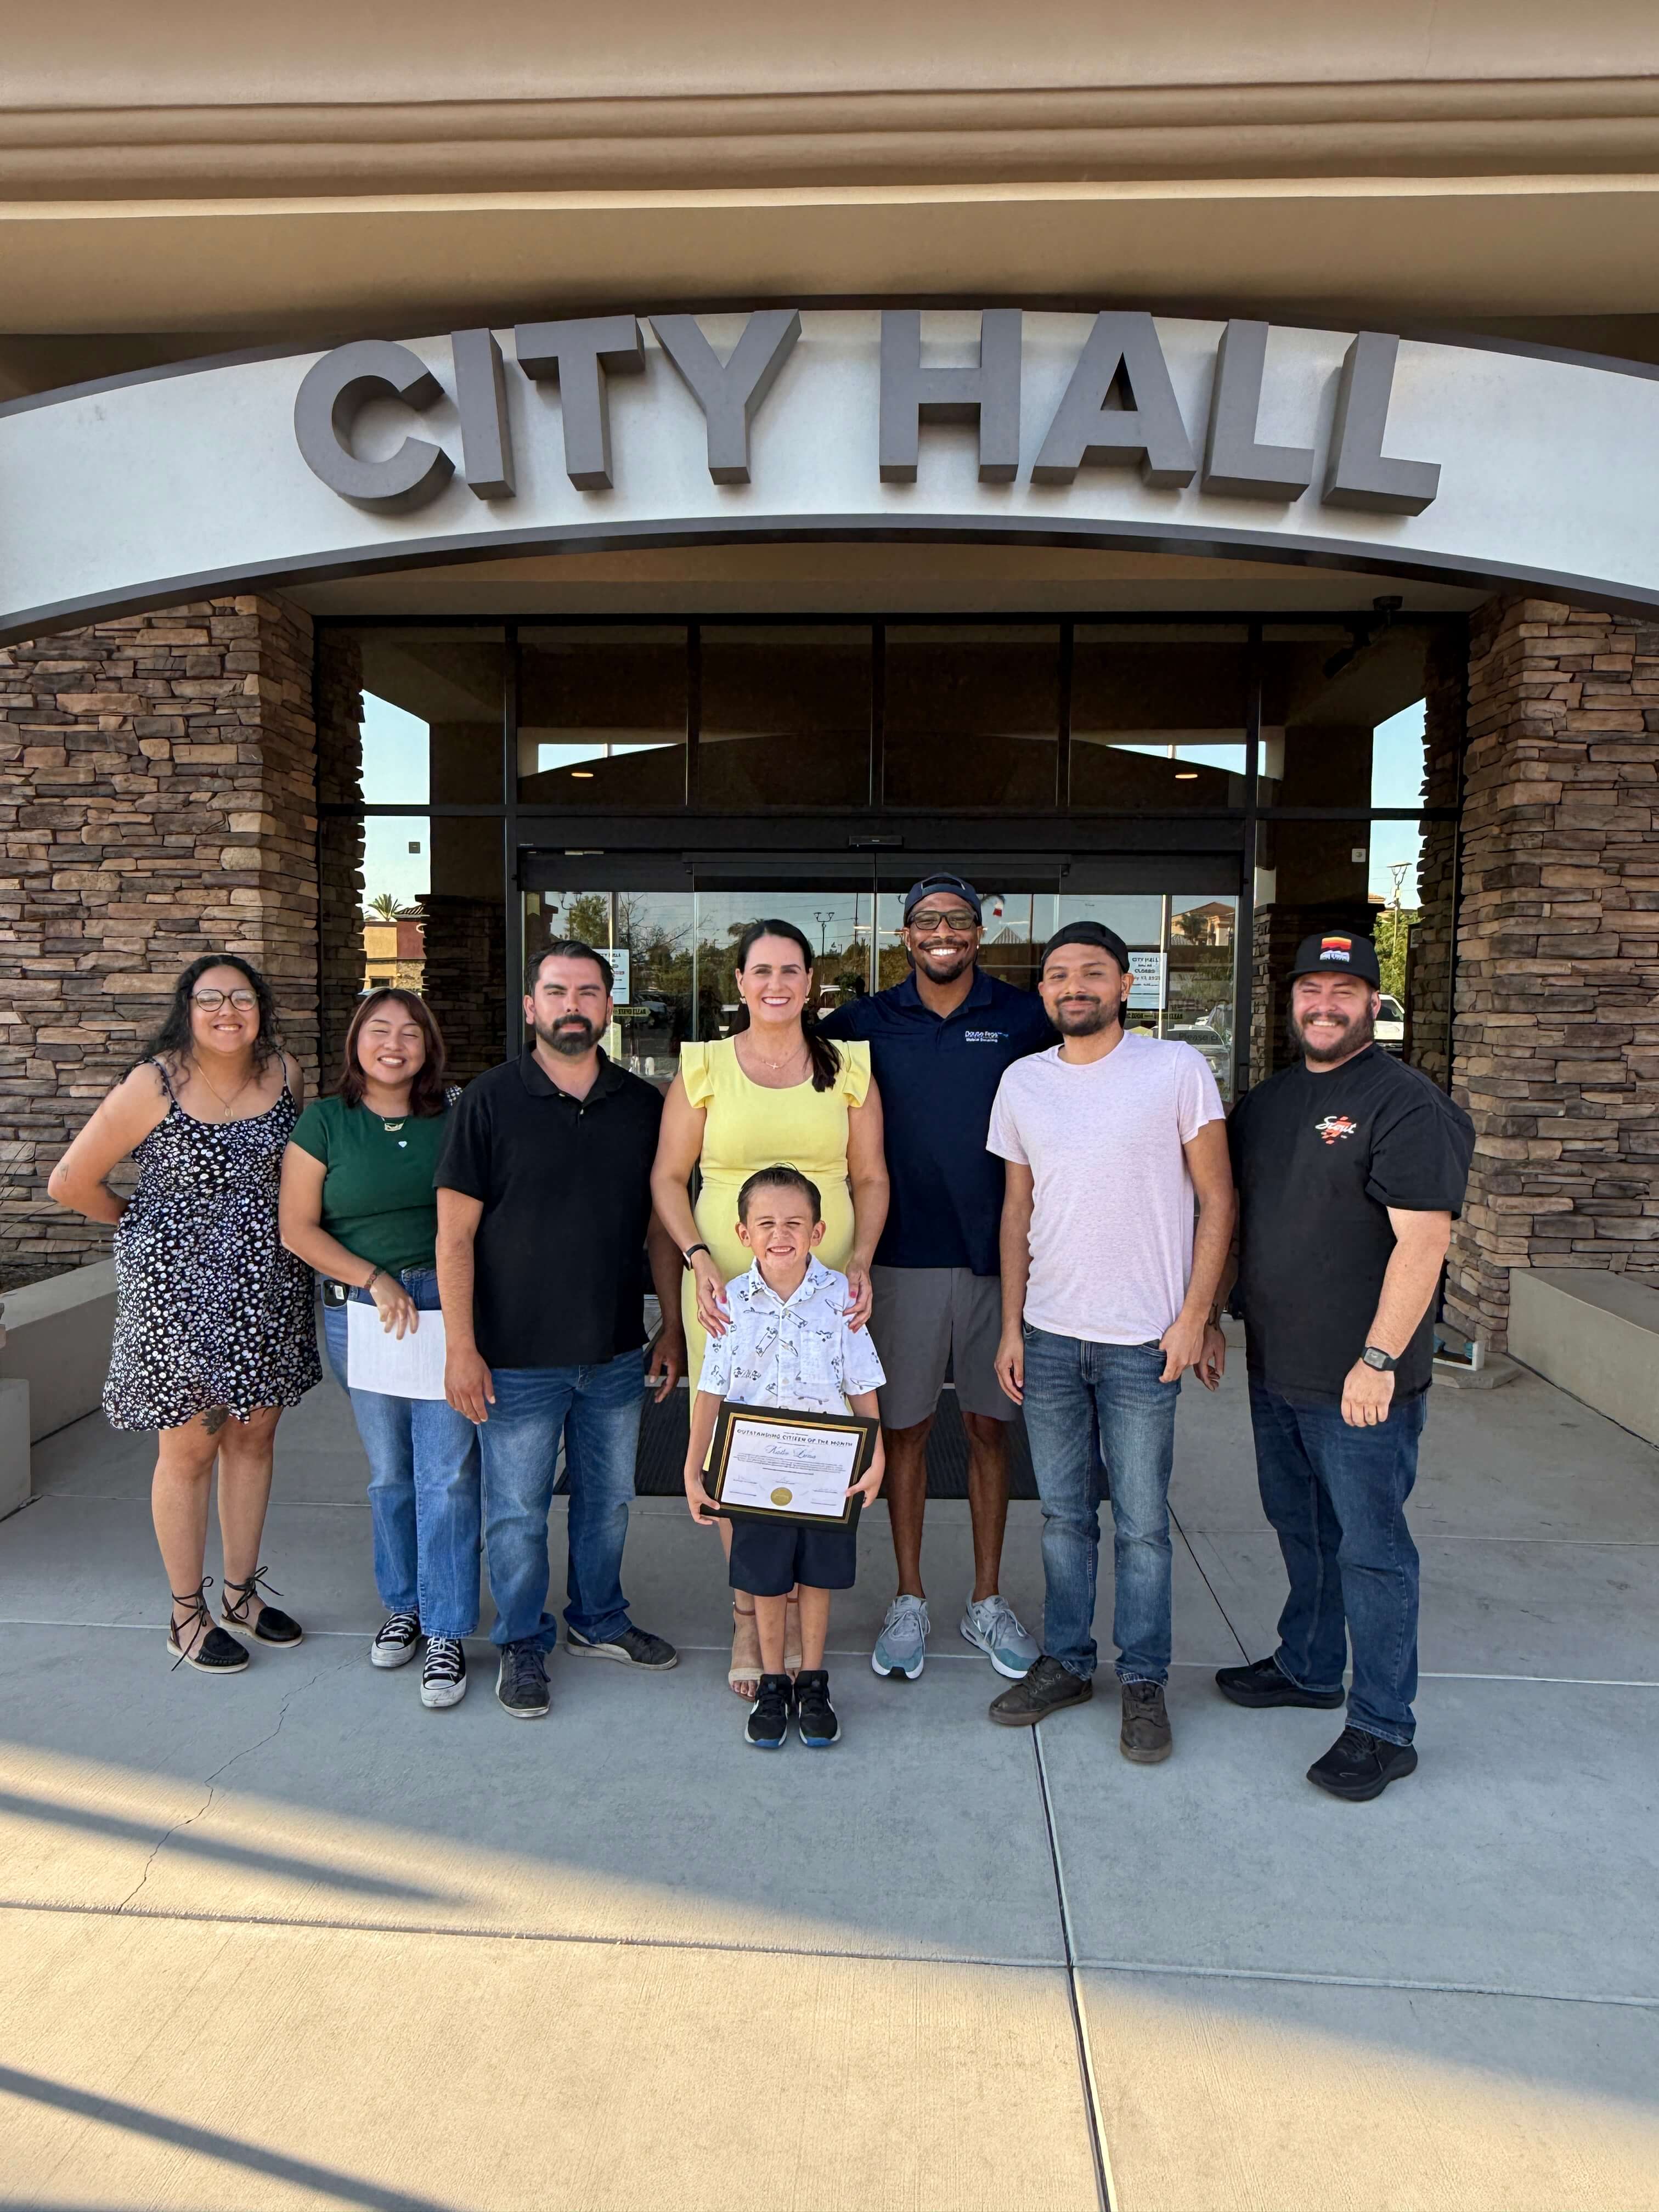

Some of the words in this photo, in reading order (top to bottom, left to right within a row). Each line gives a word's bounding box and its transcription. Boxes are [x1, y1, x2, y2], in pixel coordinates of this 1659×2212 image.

[294, 308, 801, 507] CITY
[879, 308, 1441, 516] HALL
[737, 1429, 780, 1440] OUTSTANDING
